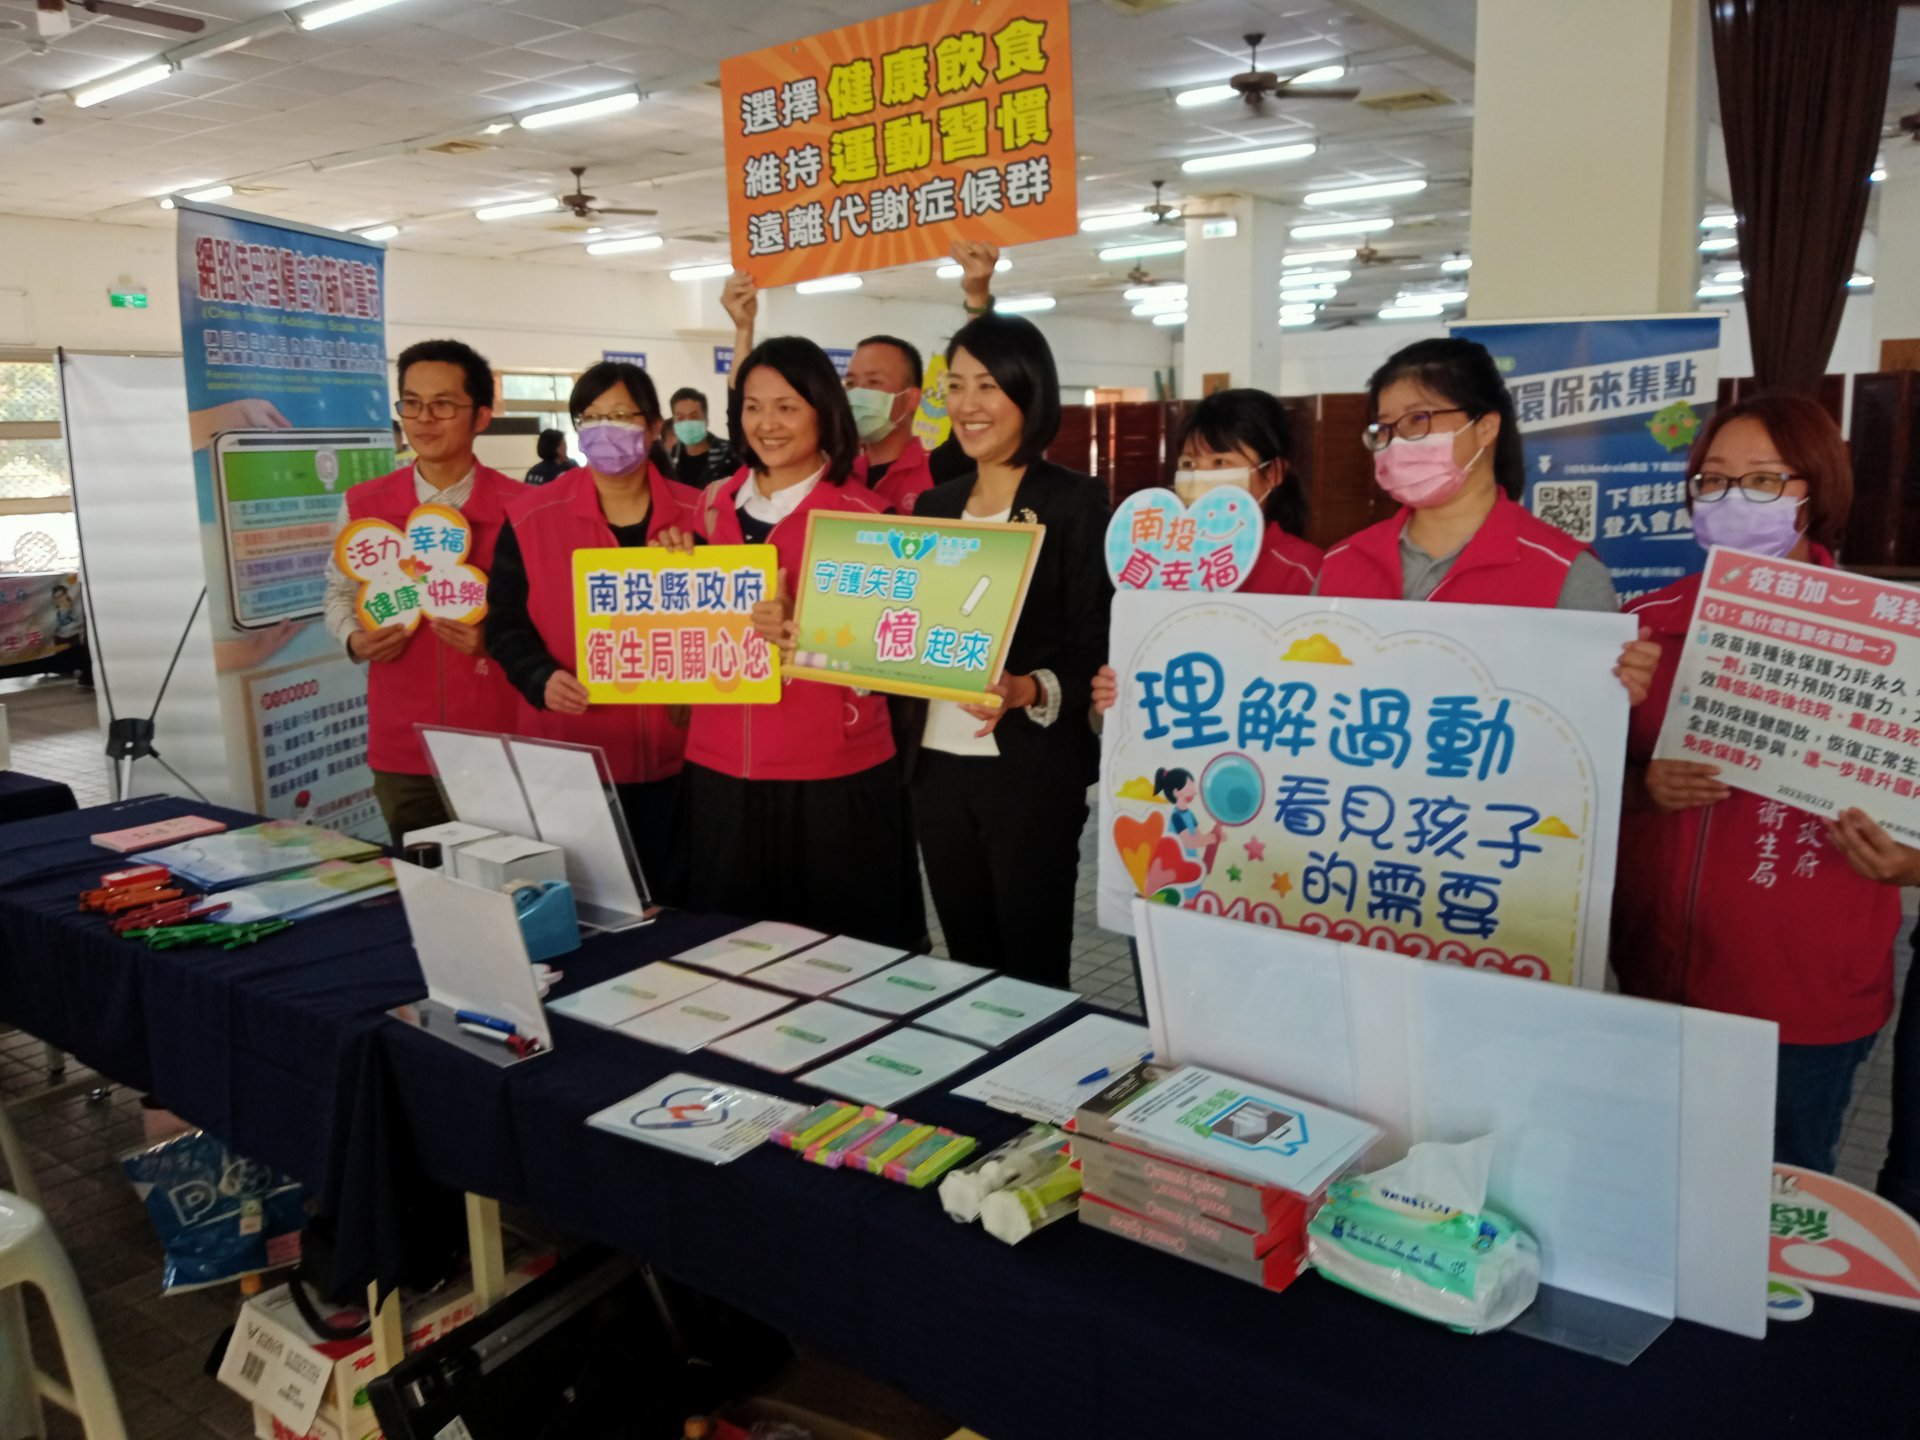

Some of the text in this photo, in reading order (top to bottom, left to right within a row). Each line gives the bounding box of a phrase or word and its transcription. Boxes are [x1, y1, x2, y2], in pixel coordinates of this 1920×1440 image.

[741, 17, 1047, 136] 選擇健康飲食
[744, 85, 1051, 199] 維持運動習慣
[749, 156, 1050, 257] 遠離代謝症候群
[346, 535, 401, 570] 活力
[409, 526, 466, 553] 幸福
[1131, 508, 1197, 552] 南投
[363, 585, 422, 624] 健康
[427, 580, 485, 607] 快樂
[588, 570, 764, 613] 南投縣政府
[815, 561, 918, 601] 守護失智
[1748, 566, 1828, 604] 疫苗加
[588, 630, 770, 681] 衛生局關心您
[1135, 651, 1516, 781] 理解過動
[1275, 775, 1543, 868] 看見孩子
[1748, 800, 1789, 888] 衛生局
[1792, 811, 1823, 880] 政府
[1303, 852, 1501, 939] 的需要
